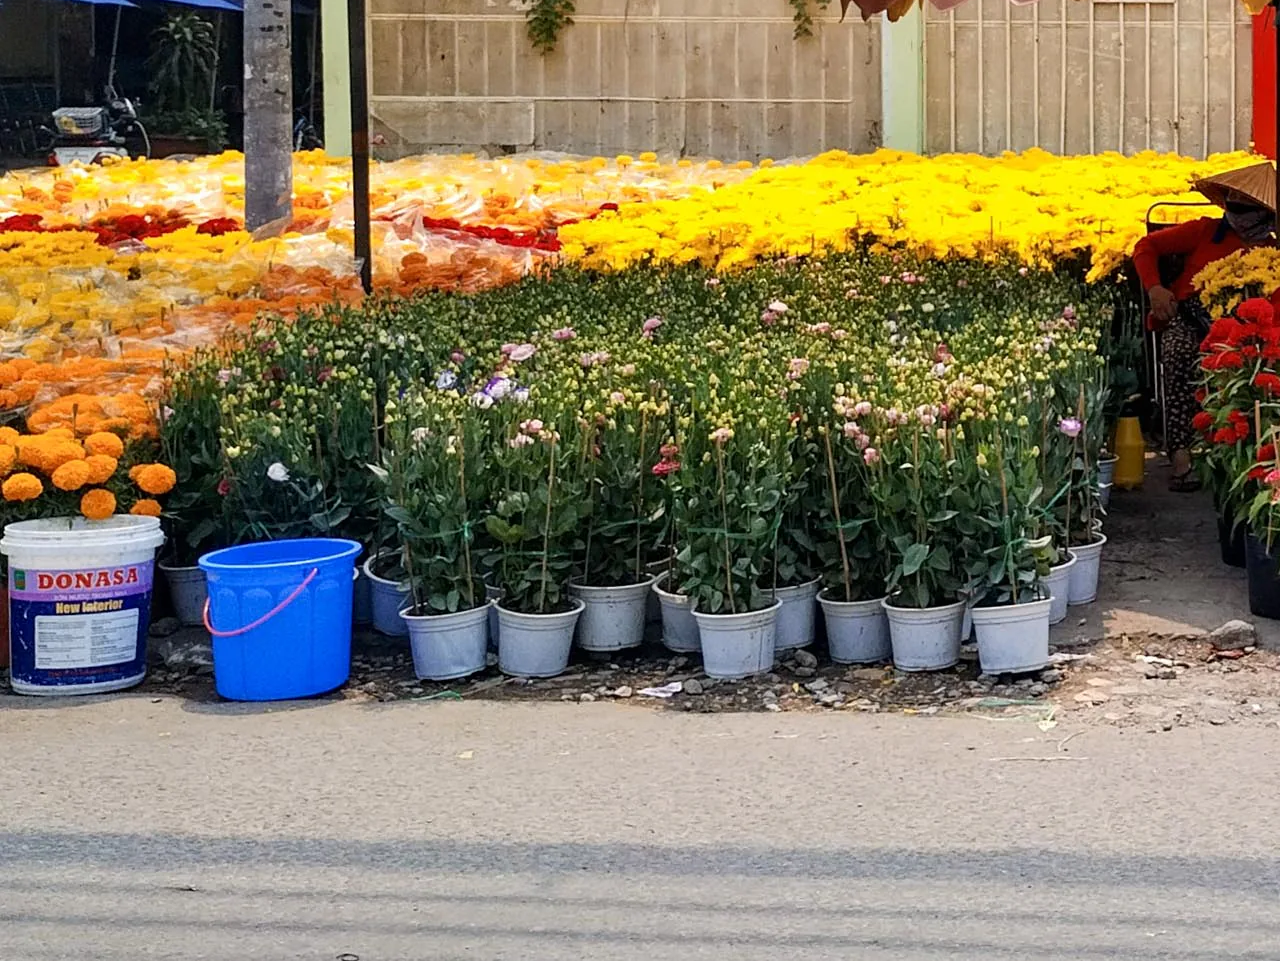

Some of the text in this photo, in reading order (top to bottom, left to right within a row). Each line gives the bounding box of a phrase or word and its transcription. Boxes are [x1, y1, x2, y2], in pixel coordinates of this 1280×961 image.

[38, 568, 138, 589] DONASA
[56, 599, 123, 614] New Interior
